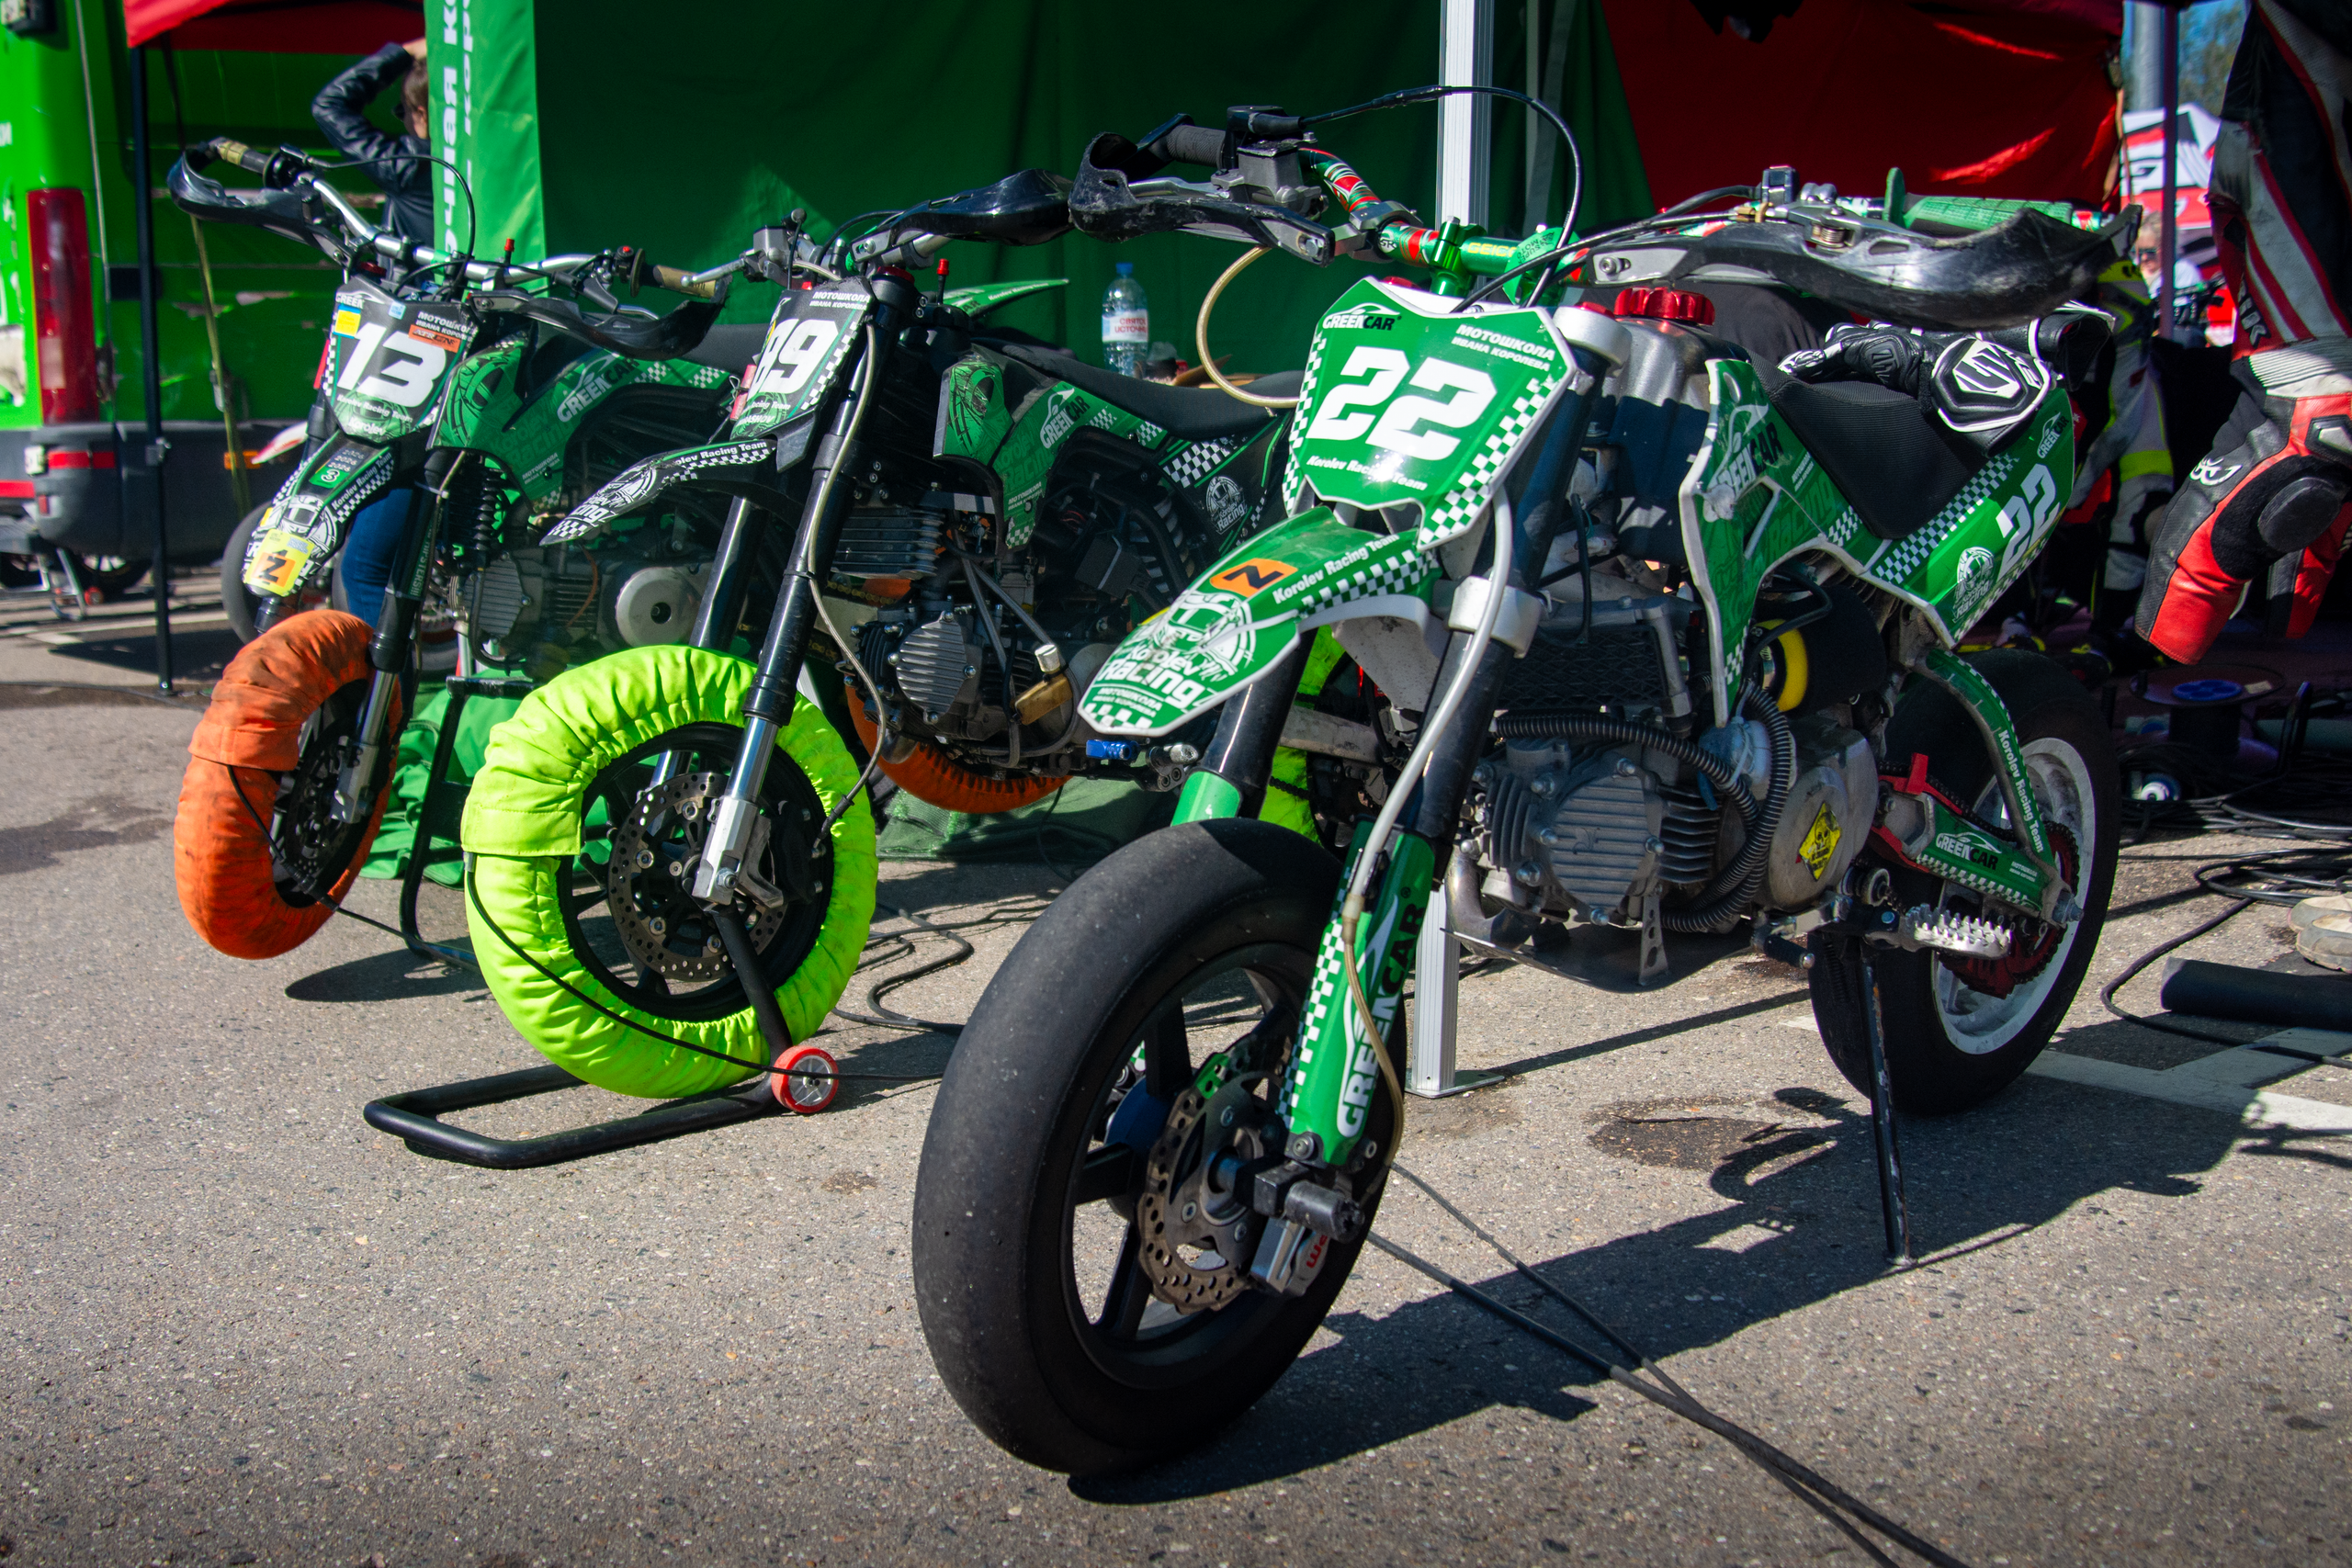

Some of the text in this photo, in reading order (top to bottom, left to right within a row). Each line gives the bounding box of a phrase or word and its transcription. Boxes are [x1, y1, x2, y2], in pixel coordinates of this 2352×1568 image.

[812, 291, 872, 303] МОТОШКОЛА
[1322, 313, 1396, 332] GREENCAR
[746, 318, 839, 401] 89
[1451, 336, 1552, 372] ИВАНА КОРОЛЕВА
[1455, 324, 1556, 361] МОТОШКОЛА
[336, 321, 447, 408] 13
[1305, 345, 1498, 461] 22
[328, 461, 351, 473] 2026
[334, 455, 358, 467] 2026
[700, 446, 739, 460] Racing
[738, 441, 768, 452] Team
[1306, 455, 1346, 471] Korolev
[1389, 473, 1429, 491] Team
[332, 482, 358, 511] Korolev
[1996, 463, 2061, 583] 22
[1272, 533, 1401, 605] Korolev Racing Team
[1128, 644, 1201, 678] Korolev
[1098, 656, 1208, 712] Racing
[1998, 729, 2044, 853] Korolev Racing Team
[1935, 833, 1999, 871] GREENCAR
